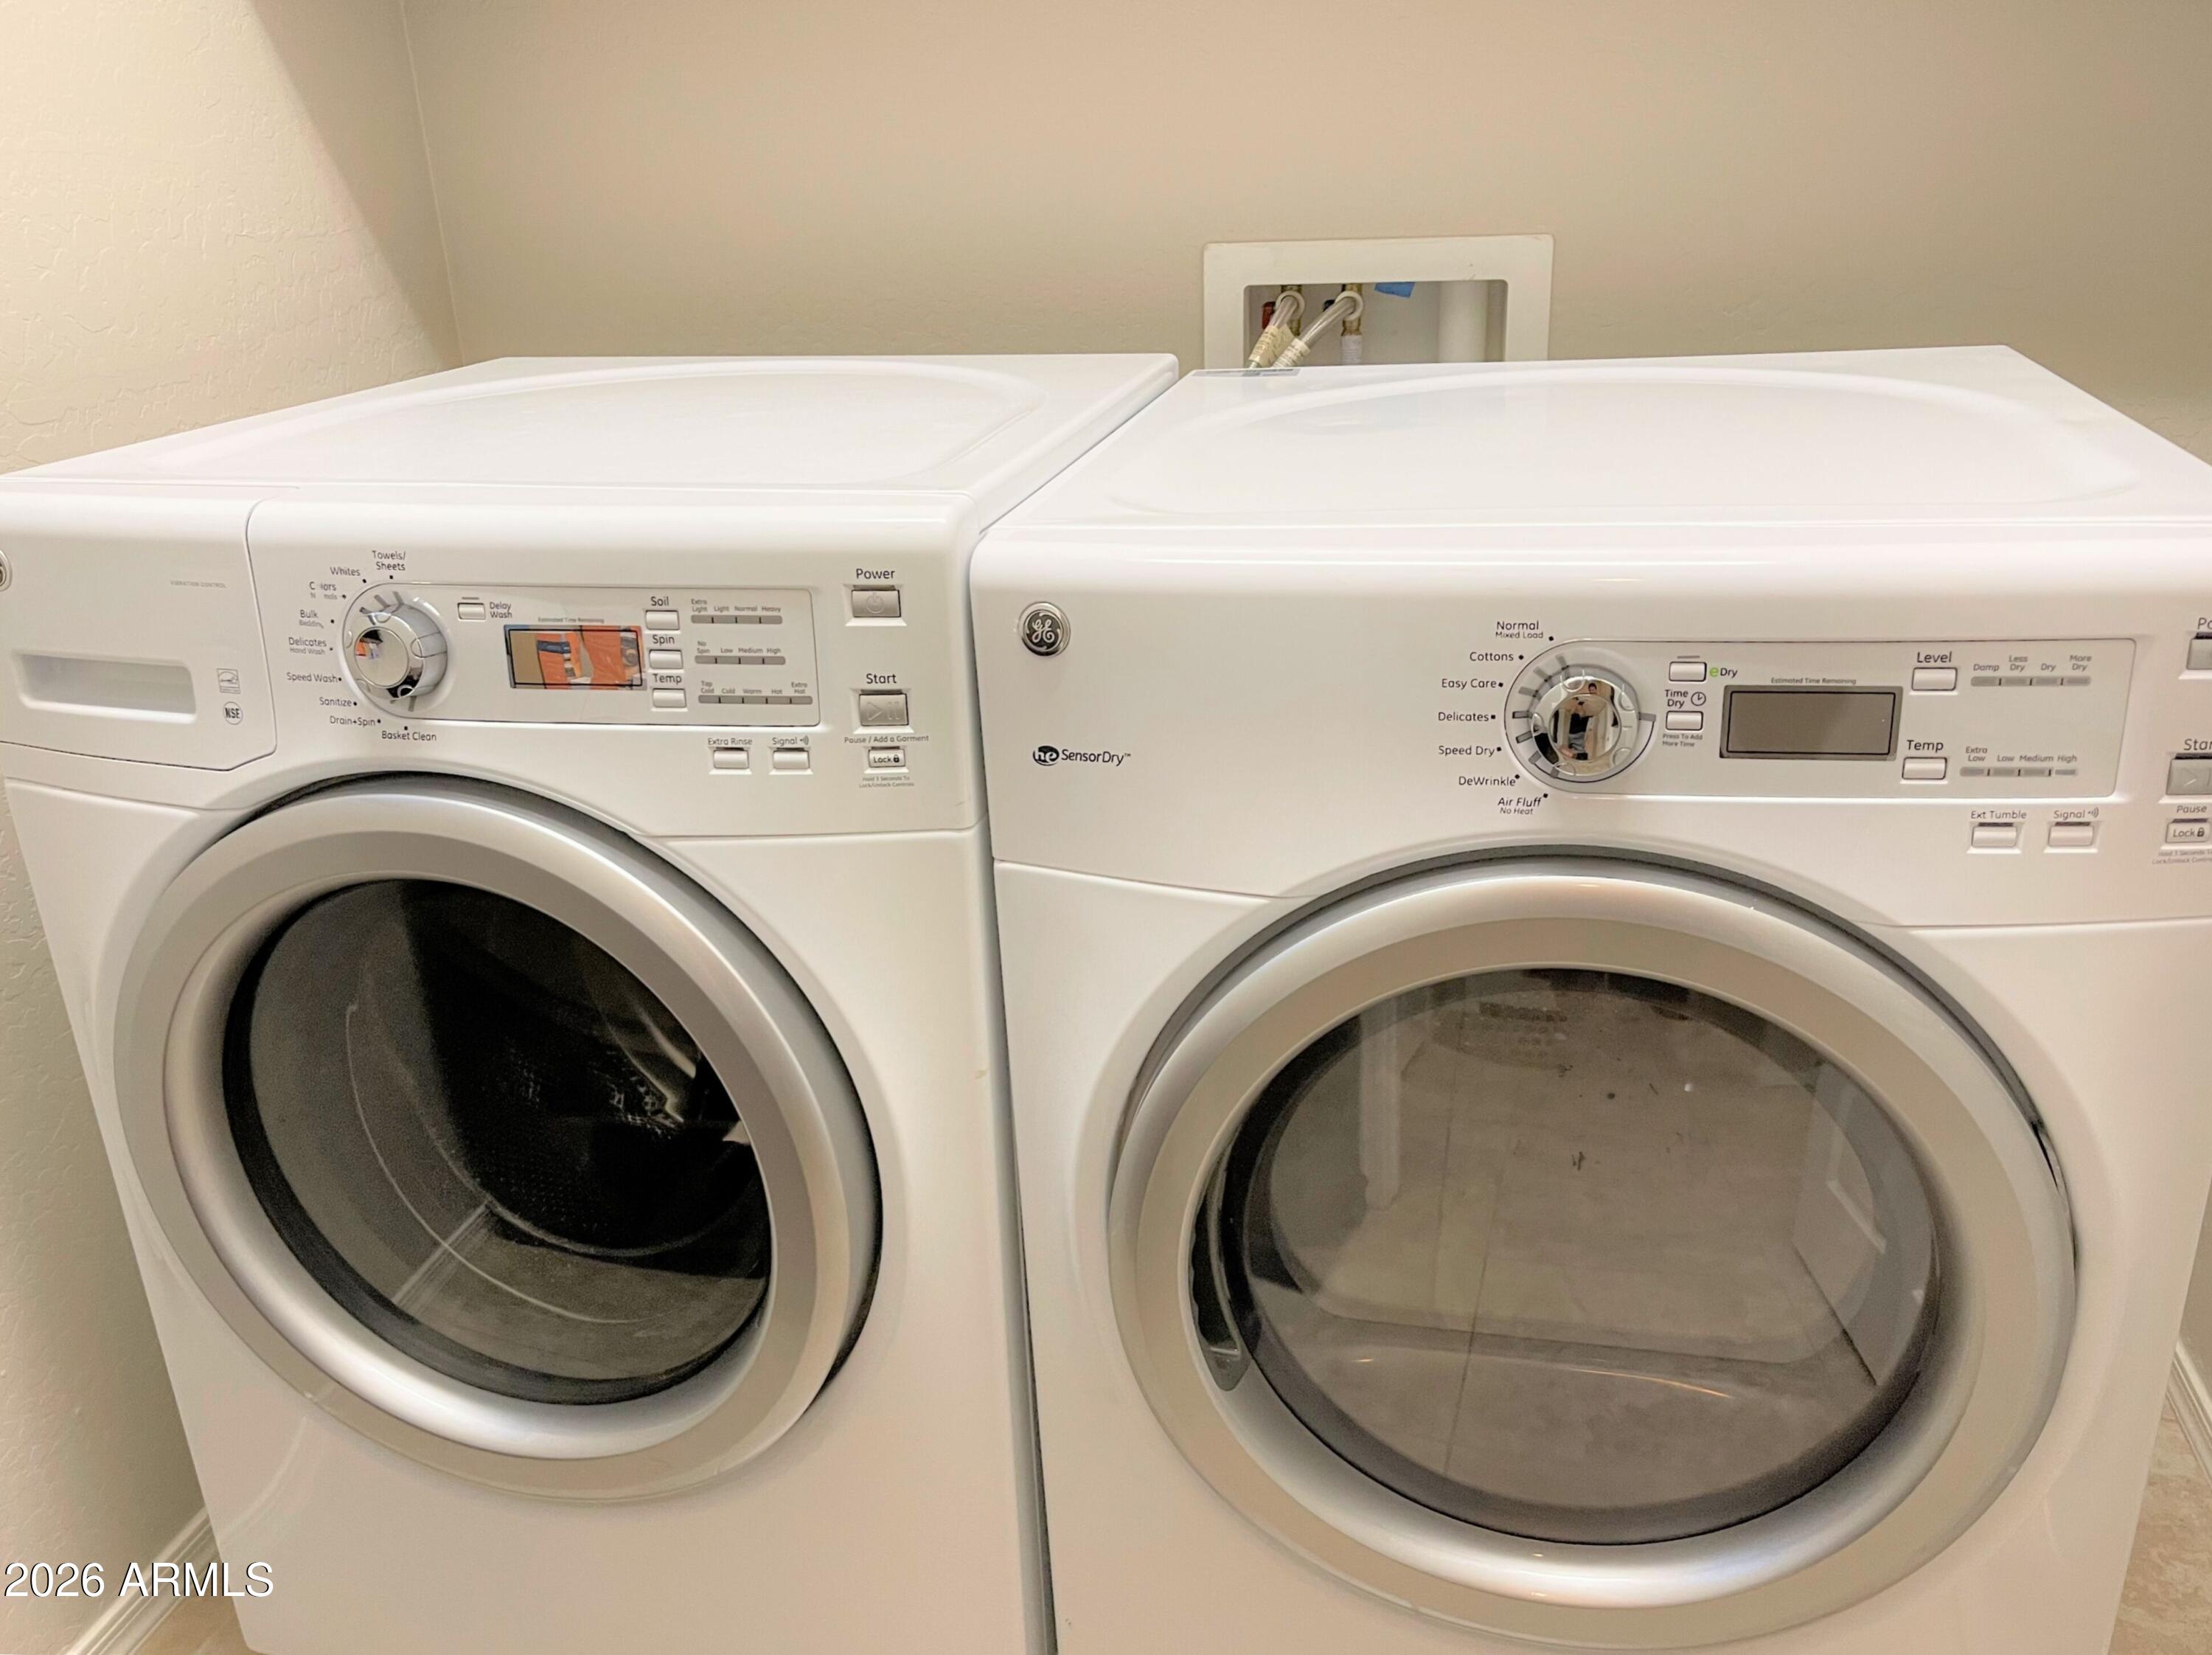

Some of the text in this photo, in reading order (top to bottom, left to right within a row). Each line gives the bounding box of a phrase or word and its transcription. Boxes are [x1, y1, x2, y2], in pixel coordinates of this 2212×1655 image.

[372, 550, 406, 561] Towels/
[330, 567, 361, 576] Whites
[376, 562, 406, 571] Sheets
[855, 568, 895, 580] Power
[310, 581, 337, 591] Clors
[650, 596, 669, 606] Soil
[490, 602, 512, 613] Delay
[300, 609, 319, 618] Bulk
[1497, 620, 1539, 631] Normal
[288, 636, 327, 647] Delicates
[653, 634, 675, 645] Spin
[1470, 652, 1514, 662] Cottons
[1917, 651, 1952, 663] Level
[1973, 664, 2000, 672] Damp
[2010, 664, 2025, 672] Dry
[2040, 664, 2056, 672] Dry
[2072, 664, 2087, 672] Dry
[286, 673, 338, 683] Speed Wash
[653, 673, 682, 684] Temp
[866, 673, 897, 684] Start
[1441, 679, 1497, 690] Easy Care
[1665, 690, 1688, 698] Time
[319, 697, 352, 707] Sanitize
[1667, 698, 1685, 709] Dry
[1438, 712, 1489, 721] Delicates
[381, 731, 437, 741] Basket Clean
[772, 738, 798, 746] Signal
[1907, 740, 1944, 752] Temp
[1439, 746, 1495, 757] Speed Dry
[2057, 755, 2077, 763] High
[1458, 776, 1516, 786] DeWrinkle
[1498, 797, 1542, 807] Air Fluff
[2177, 805, 2207, 813] Pause
[1971, 811, 2027, 819] Ext Tumble
[2053, 811, 2085, 821] Signal
[2173, 828, 2195, 837] Lock
